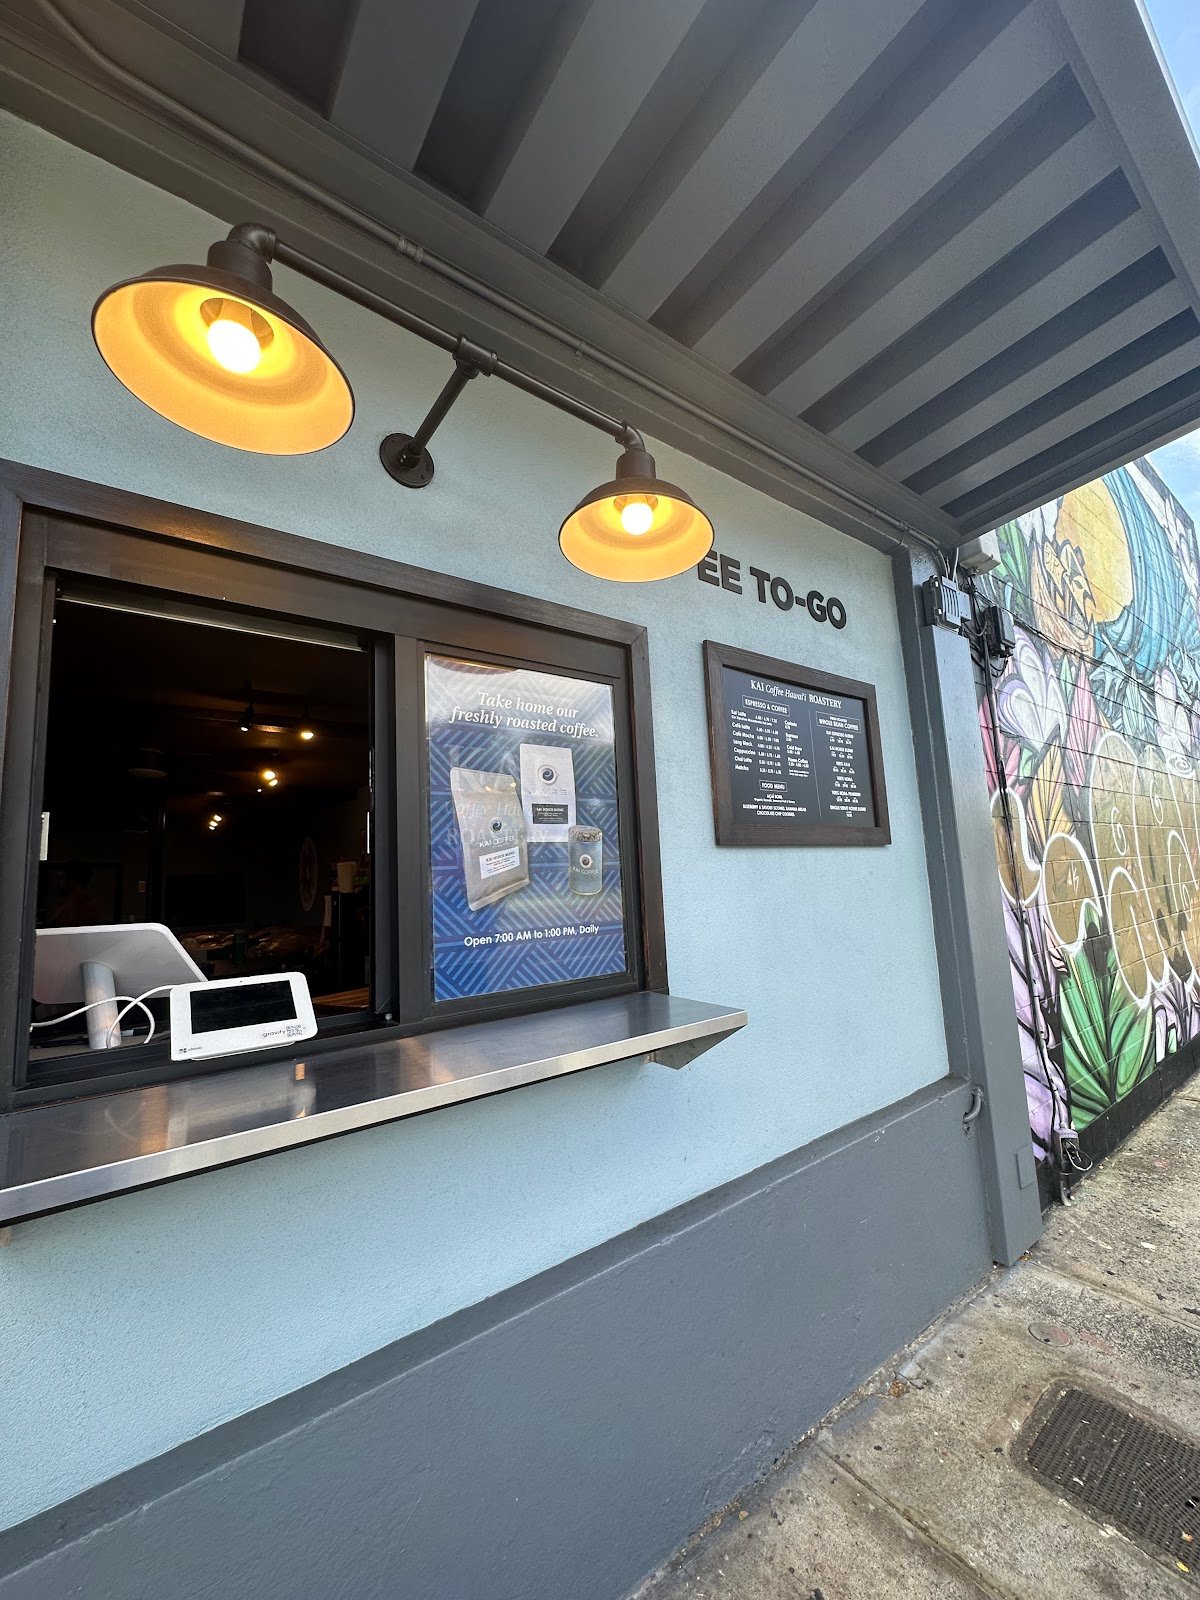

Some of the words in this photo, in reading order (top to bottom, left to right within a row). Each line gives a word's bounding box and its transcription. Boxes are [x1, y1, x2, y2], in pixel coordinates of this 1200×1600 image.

[749, 566, 847, 629] TO-GO
[478, 692, 513, 708] Take
[515, 698, 554, 715] home
[556, 706, 578, 719] our
[750, 680, 764, 692] KAI
[765, 684, 784, 697] Coffee
[808, 693, 842, 709] ROASTERY
[448, 706, 502, 728] freshly
[506, 714, 557, 732] roasted
[559, 722, 599, 738] coffee.
[771, 704, 788, 714] COFFEE
[464, 936, 493, 948] Open
[494, 933, 514, 943] 7:00
[515, 930, 532, 941] AM
[533, 930, 543, 939] to
[544, 928, 561, 938] 1:00
[562, 926, 577, 936] PM,
[579, 923, 600, 935] Daily
